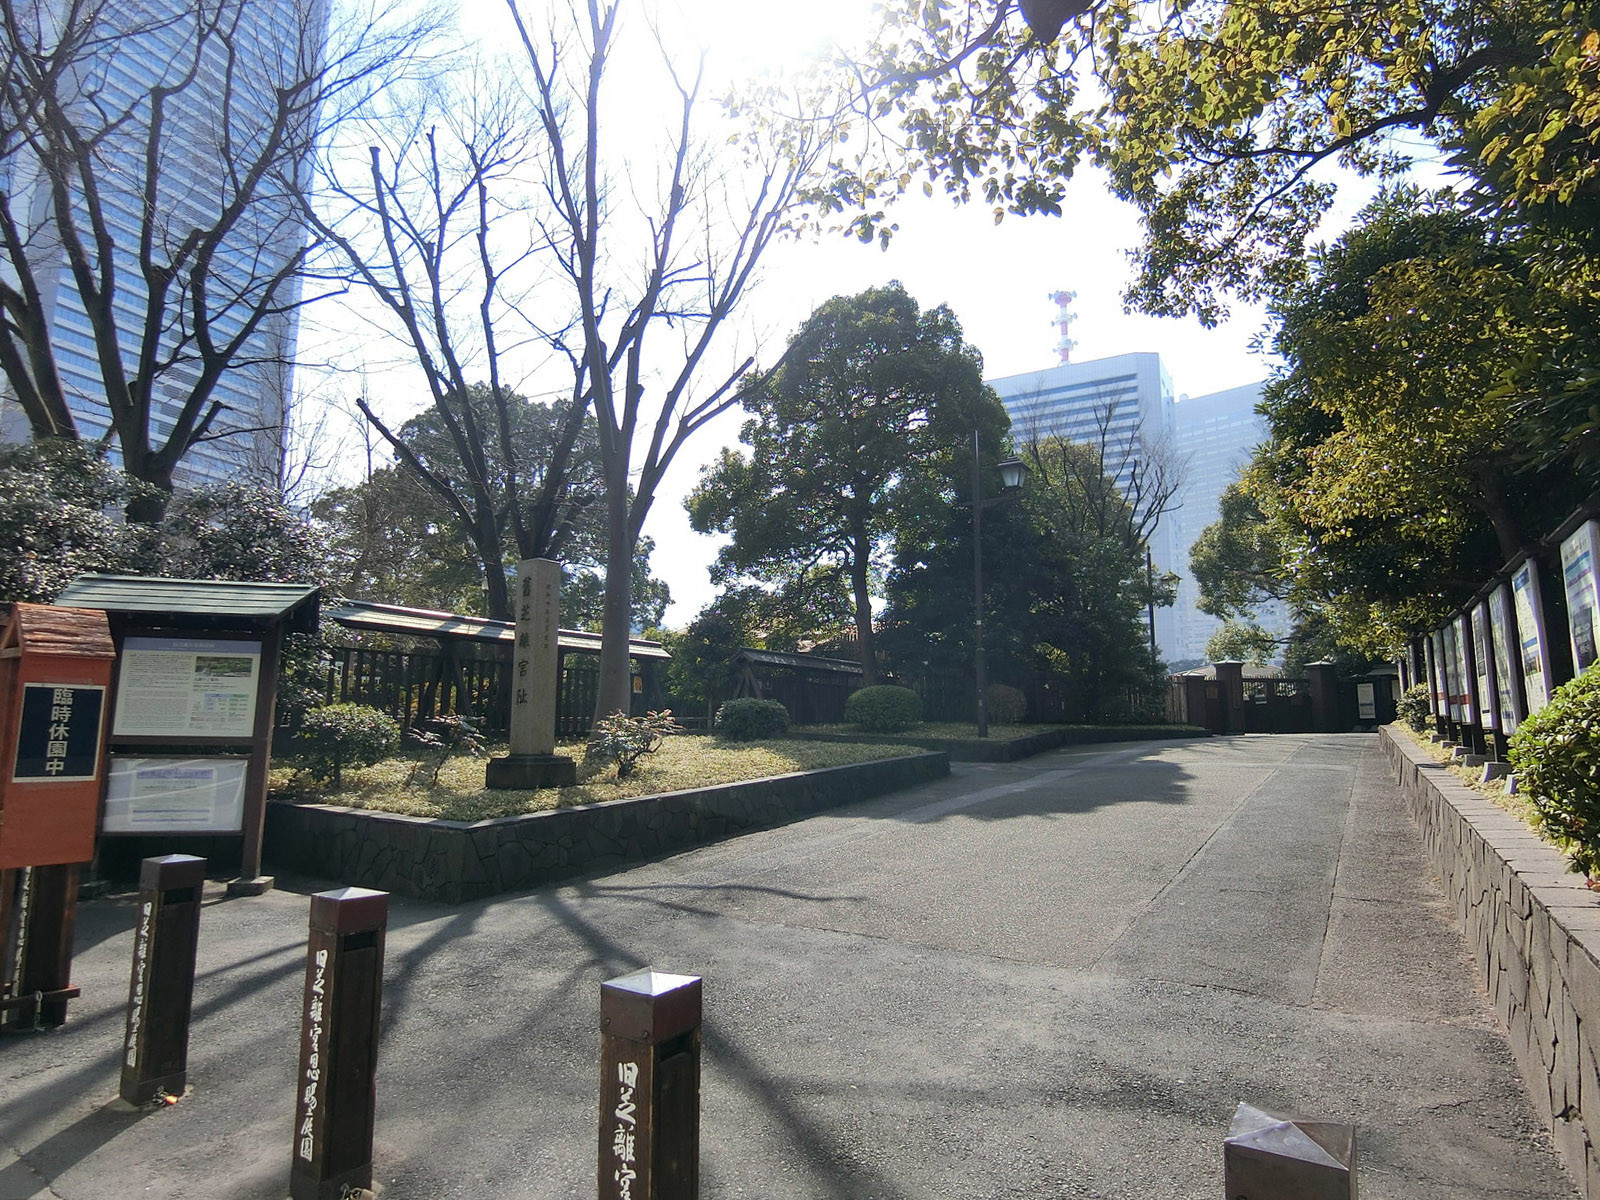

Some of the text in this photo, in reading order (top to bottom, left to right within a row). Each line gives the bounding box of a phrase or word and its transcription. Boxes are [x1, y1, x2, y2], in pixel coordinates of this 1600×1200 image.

[45, 687, 74, 777] 臨時休園中
